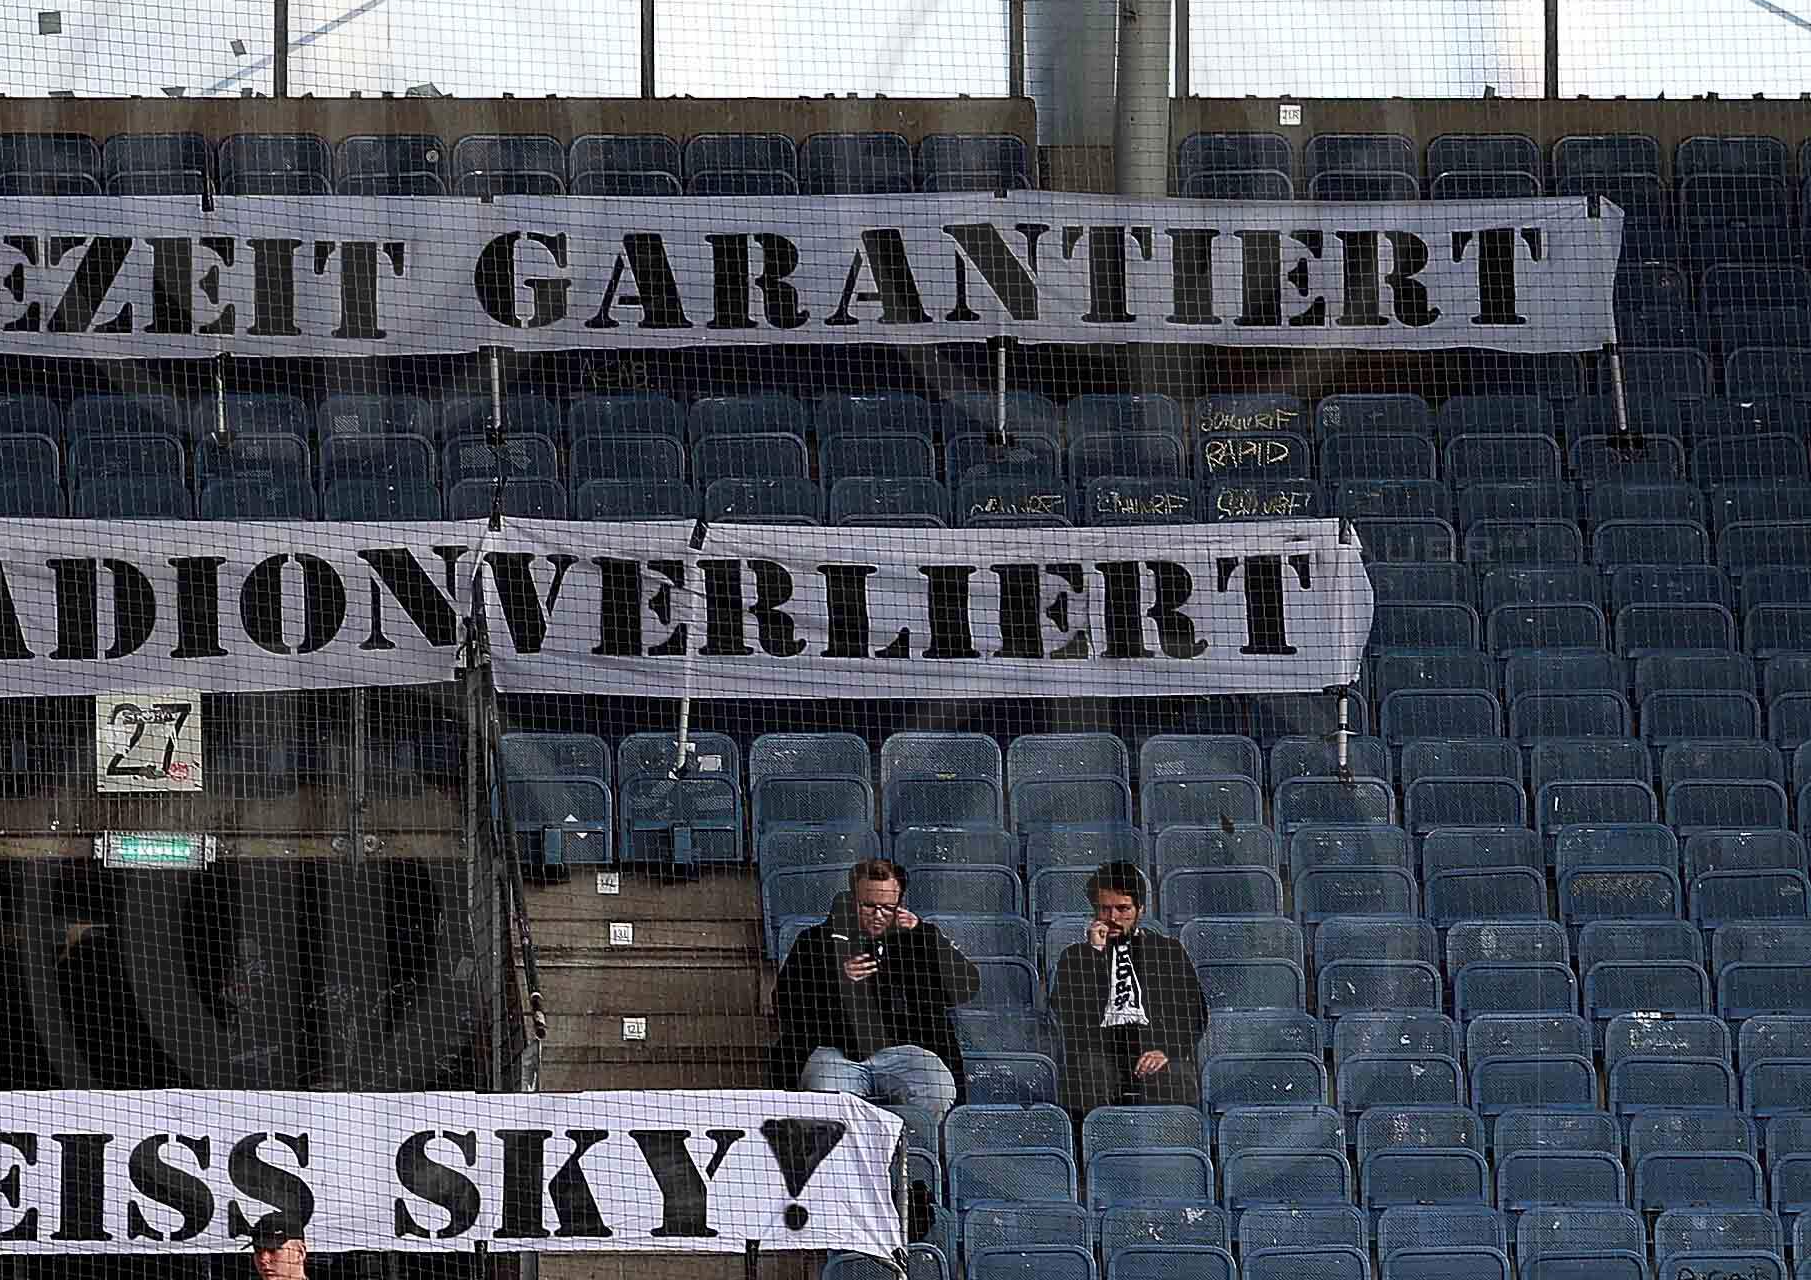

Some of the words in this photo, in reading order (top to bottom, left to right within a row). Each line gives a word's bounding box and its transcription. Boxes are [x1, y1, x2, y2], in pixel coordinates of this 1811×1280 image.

[473, 222, 1546, 331] GARANTIERT
[106, 703, 192, 778] 27
[393, 1116, 848, 1239] SKY!
